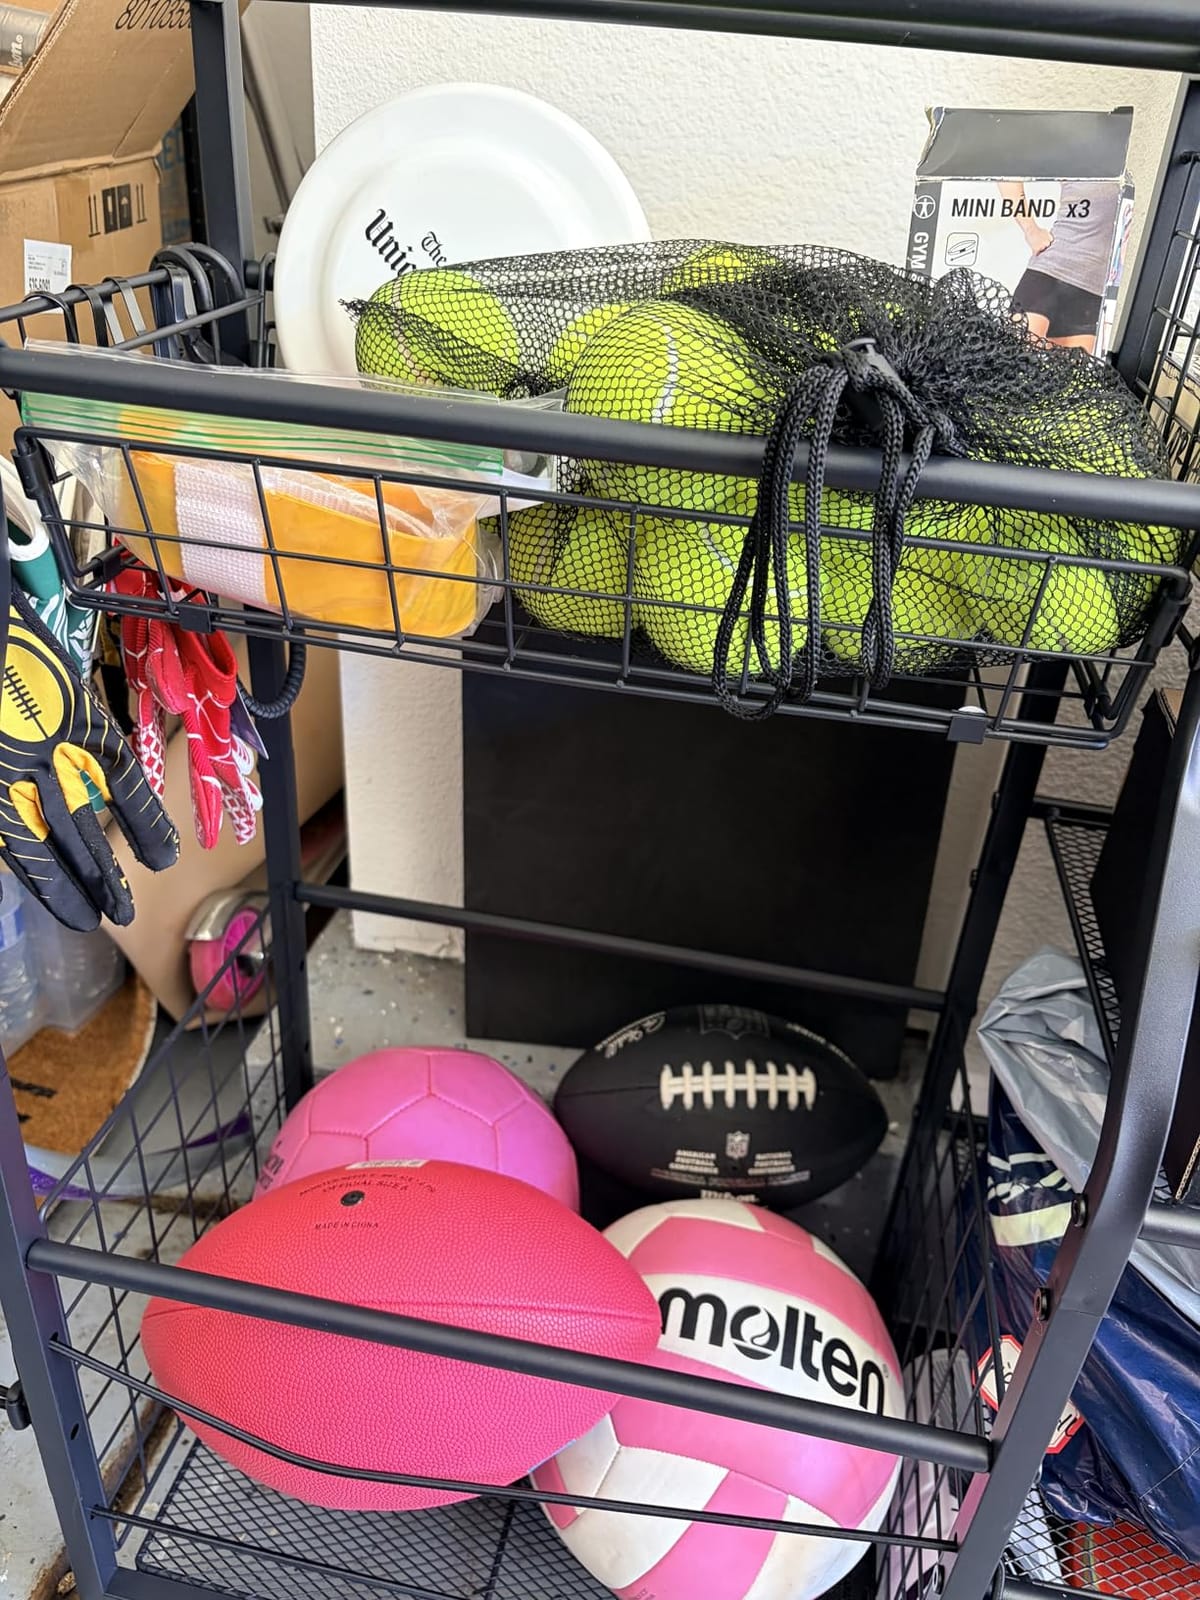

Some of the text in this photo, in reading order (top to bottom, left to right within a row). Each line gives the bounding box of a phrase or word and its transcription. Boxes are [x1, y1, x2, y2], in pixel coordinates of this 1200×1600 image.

[951, 198, 1091, 219] MINI BAND x3
[421, 231, 447, 267] The
[911, 231, 929, 269] GYM
[658, 1287, 884, 1416] molten
